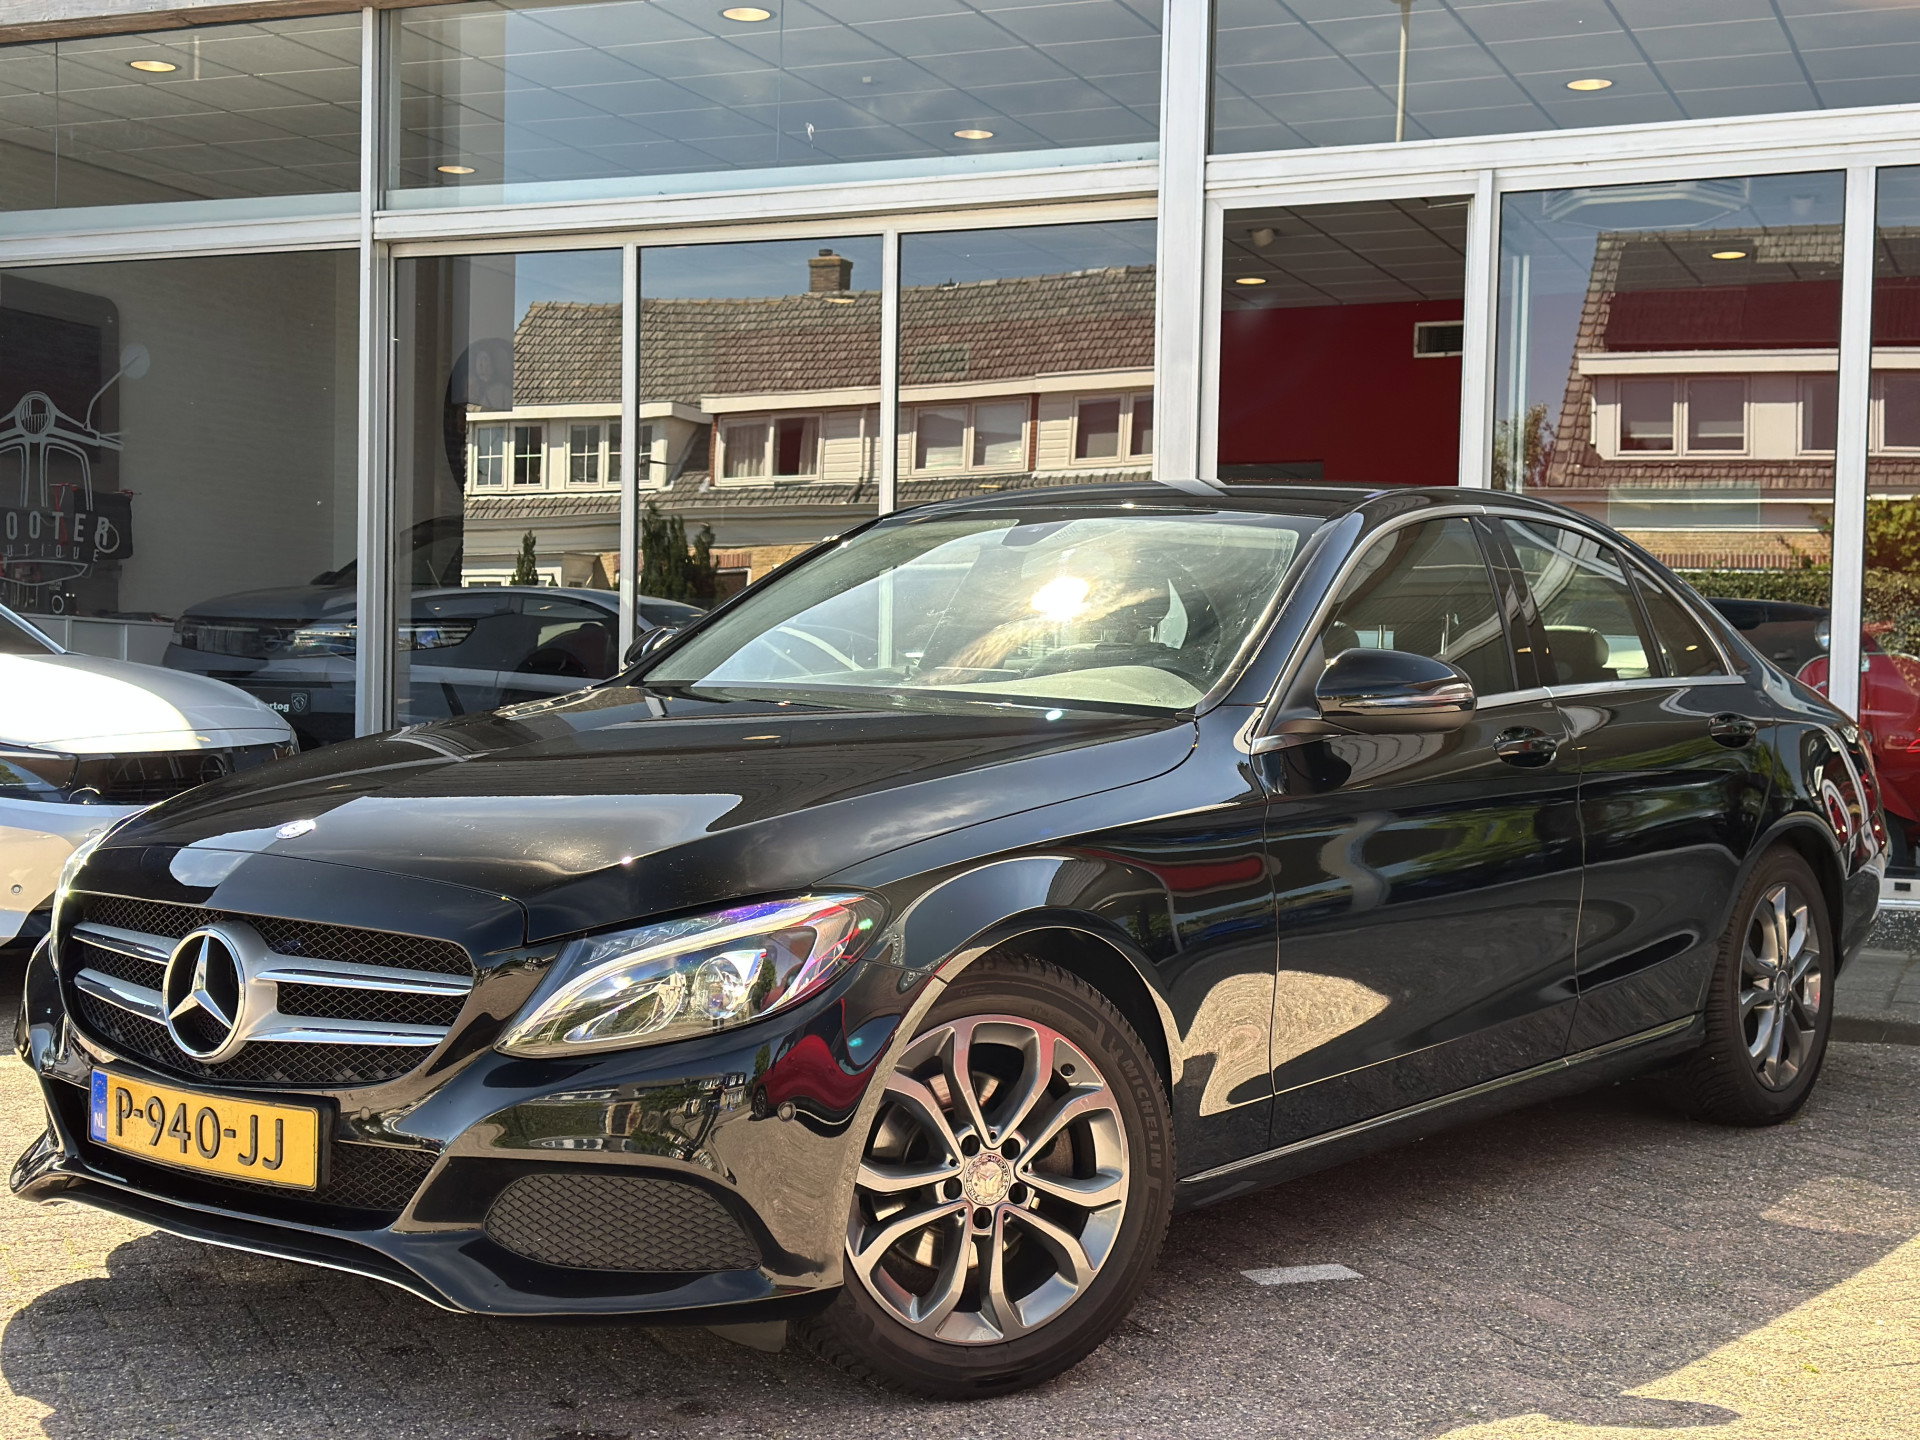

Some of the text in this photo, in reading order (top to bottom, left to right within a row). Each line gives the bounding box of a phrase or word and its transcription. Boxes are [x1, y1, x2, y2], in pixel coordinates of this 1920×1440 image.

[6, 511, 109, 545] OOTER
[6, 543, 100, 562] UTIQUE
[268, 702, 289, 712] rtog
[94, 1111, 106, 1130] NL
[1121, 1058, 1162, 1170] MICHELIN
[115, 1086, 284, 1171] P-940-JJ
